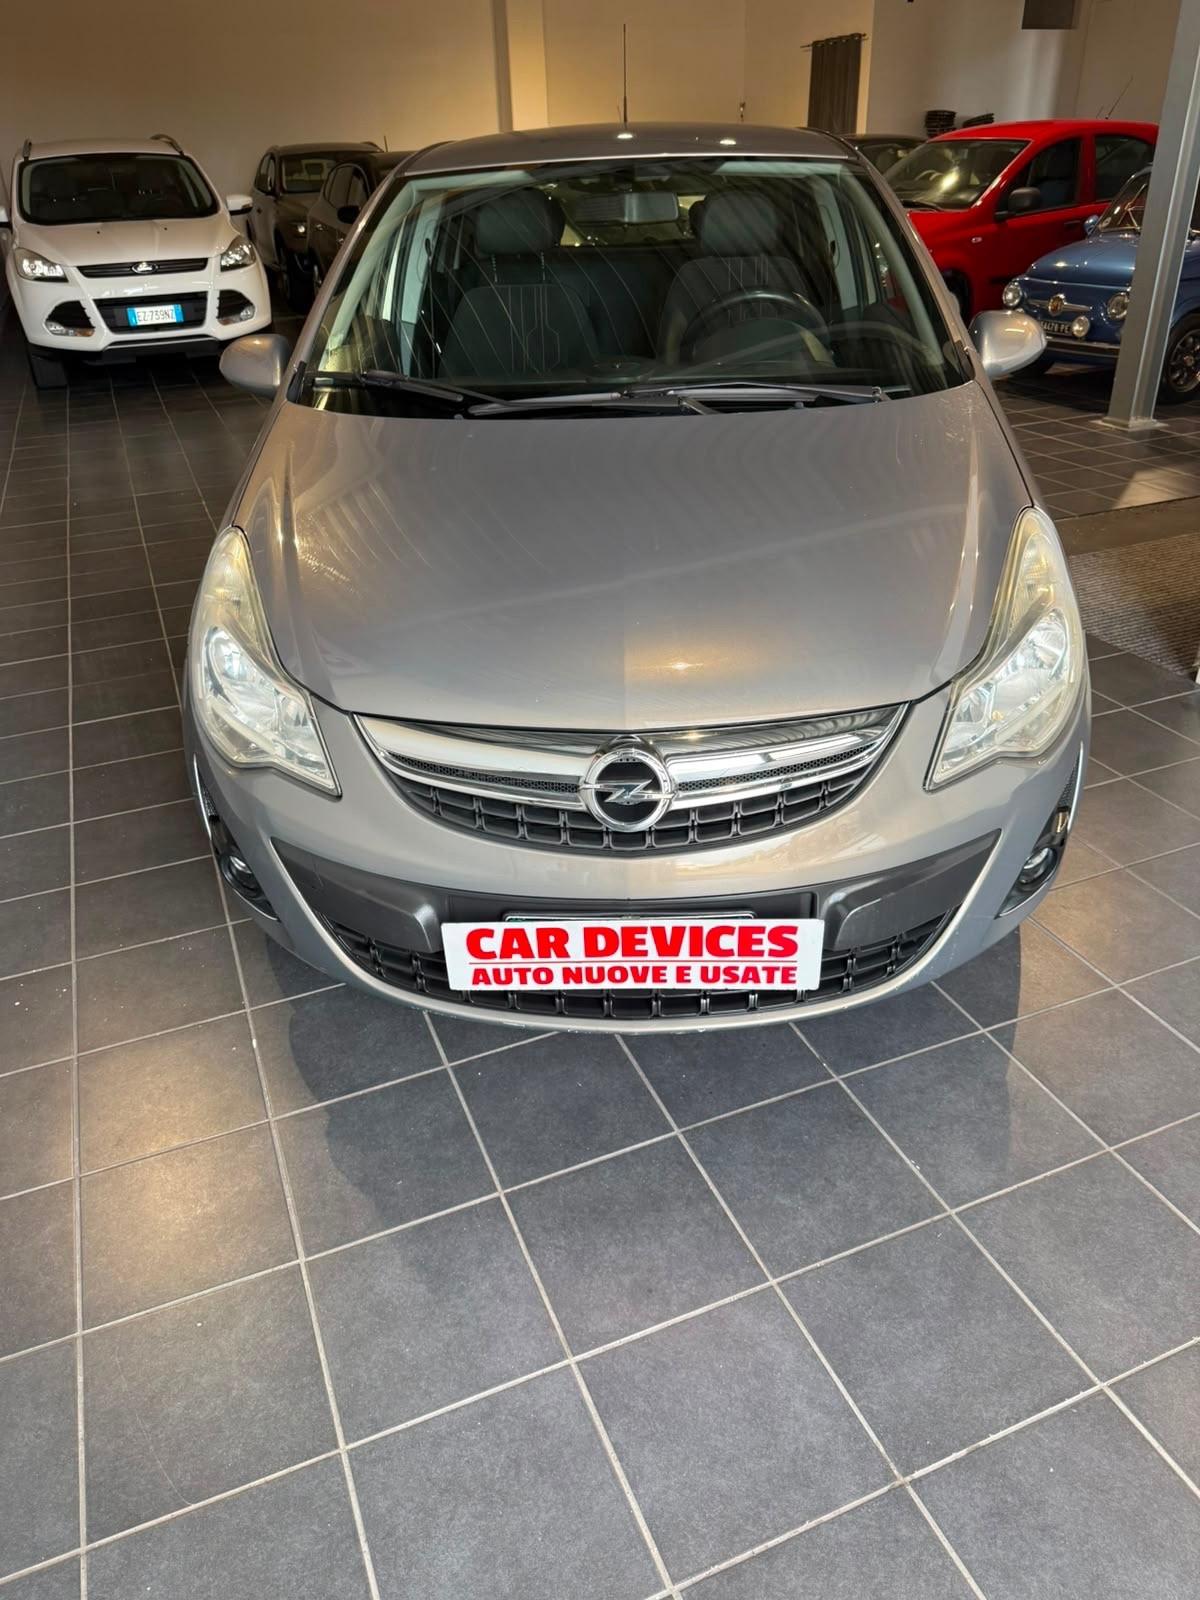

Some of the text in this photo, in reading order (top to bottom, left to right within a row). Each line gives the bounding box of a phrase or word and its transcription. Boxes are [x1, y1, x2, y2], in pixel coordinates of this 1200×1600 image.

[466, 924, 798, 960] CAR DEVICES
[472, 965, 797, 986] AUTO NUOVE E USATE
